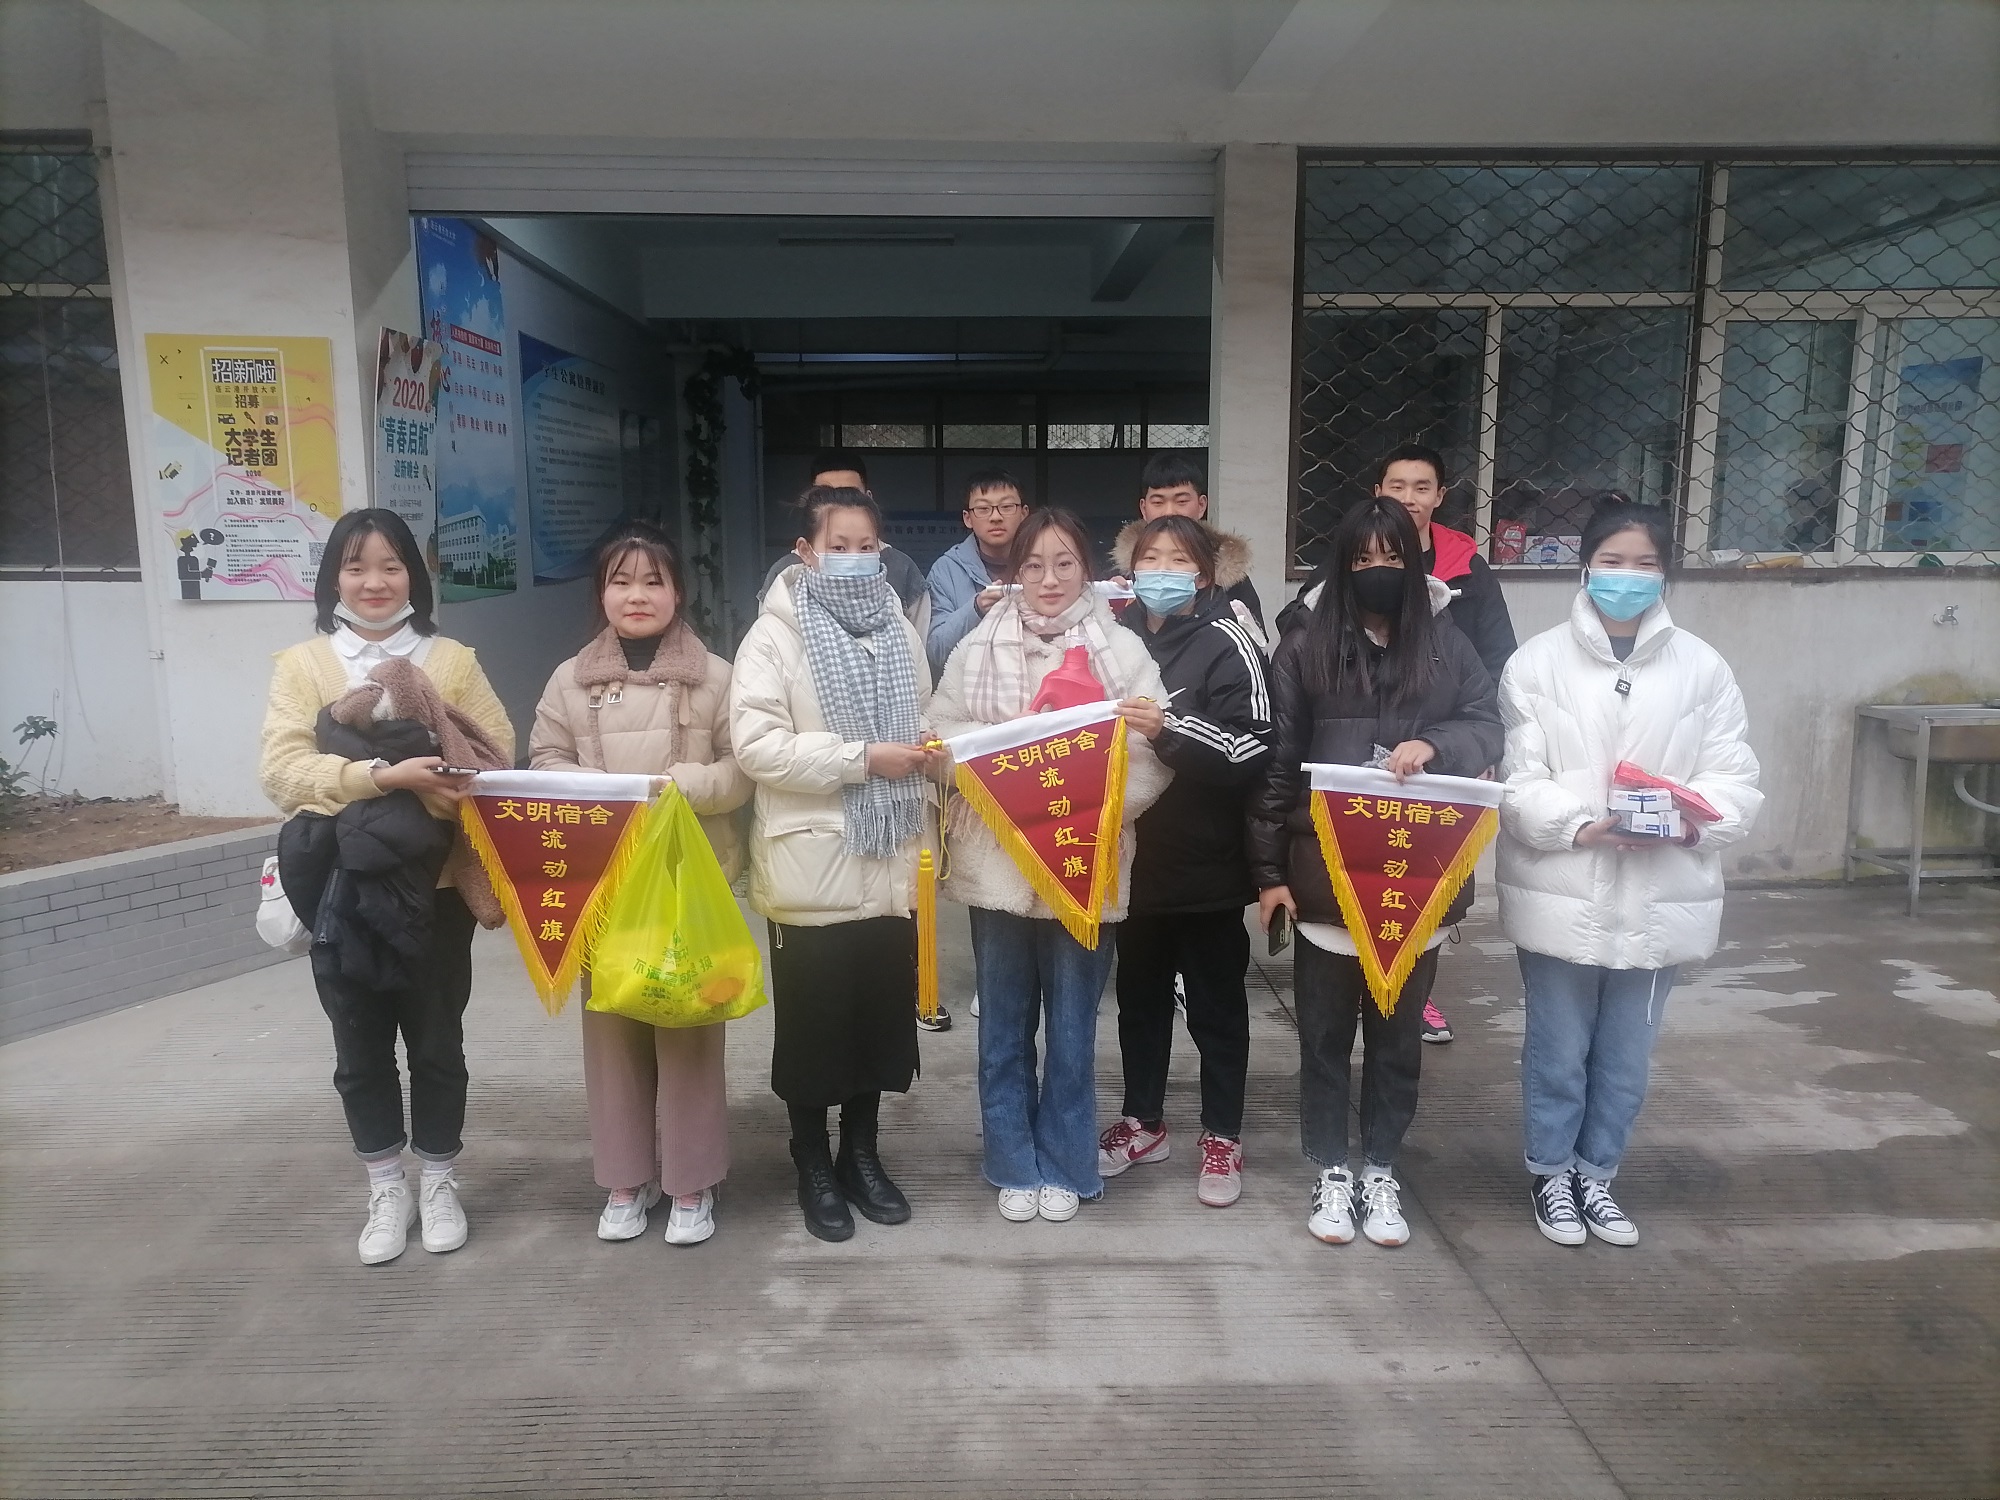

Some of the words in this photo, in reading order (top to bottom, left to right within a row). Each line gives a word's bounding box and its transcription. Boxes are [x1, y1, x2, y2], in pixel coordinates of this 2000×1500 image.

[211, 359, 277, 383] 招新啦
[235, 393, 260, 409] 招募
[392, 376, 425, 412] 2020
[224, 428, 278, 447] 大学生
[226, 447, 278, 467] 记者团
[991, 729, 1100, 776] 文明宿舍
[494, 799, 615, 826] 文明宿舍
[1039, 766, 1089, 878] 流动红旗
[1343, 796, 1464, 827] 文明宿舍
[539, 829, 568, 942] 流动红旗
[1378, 827, 1413, 942] 流动红旗
